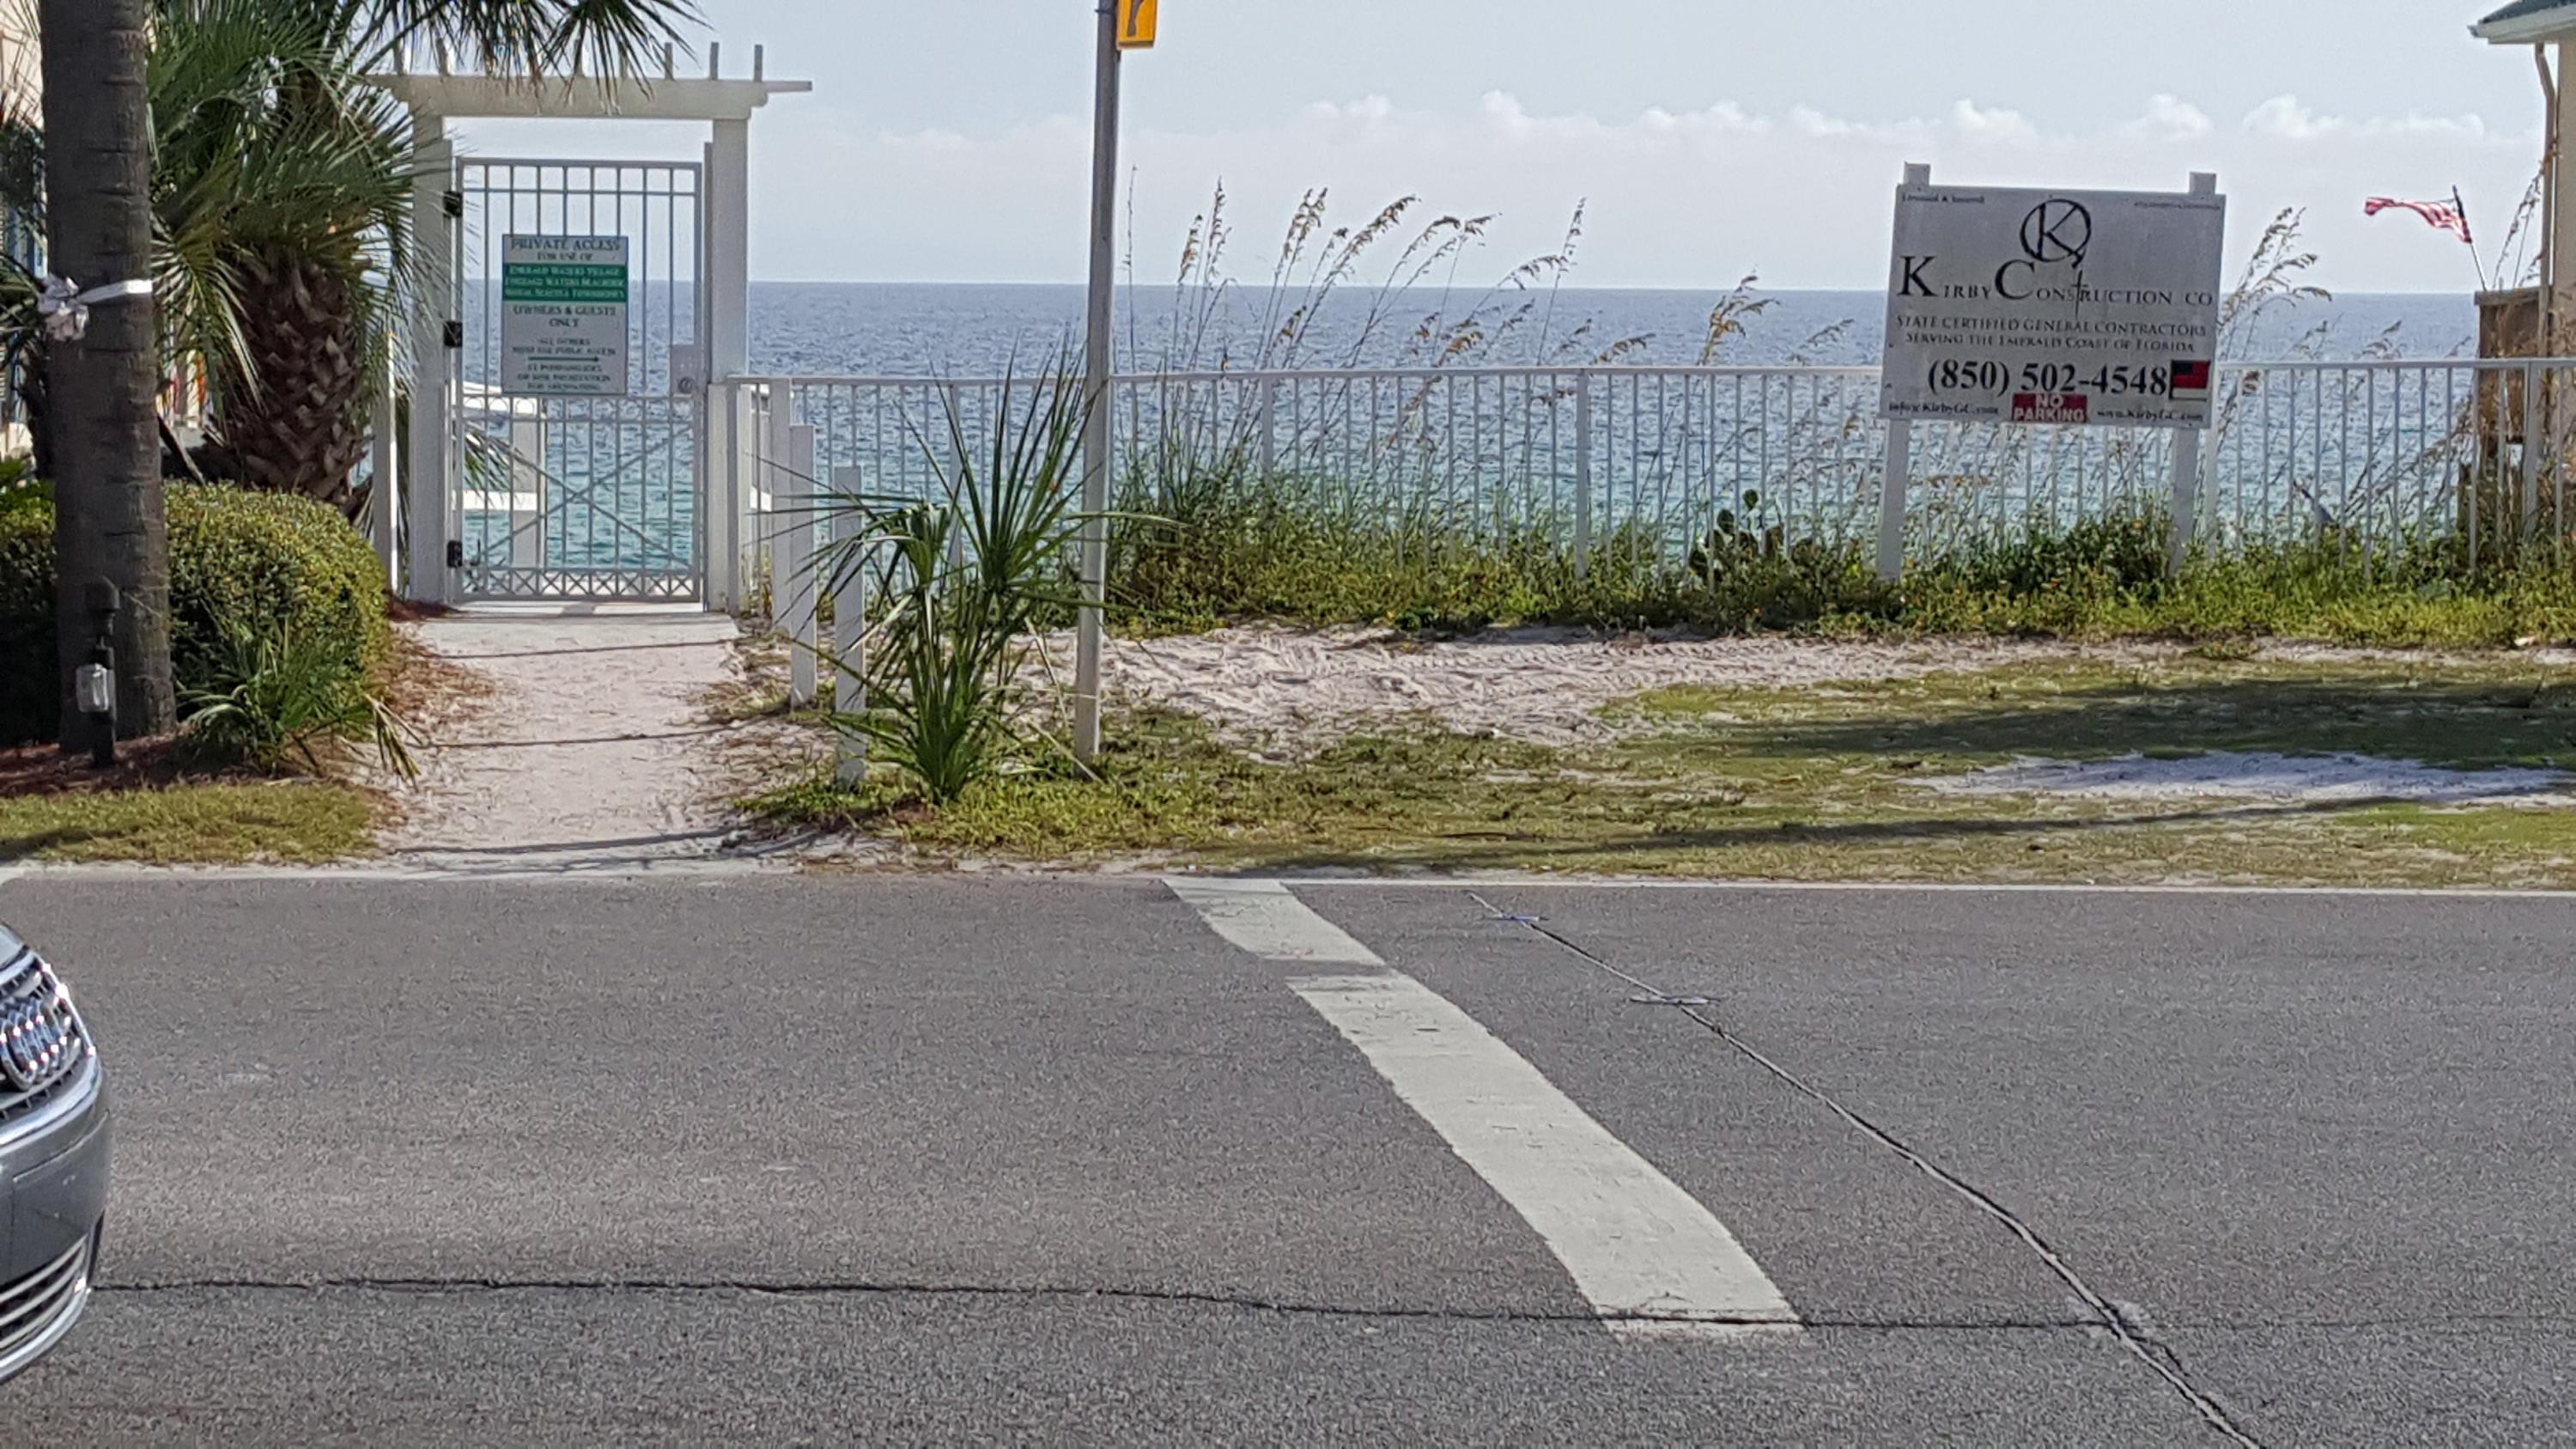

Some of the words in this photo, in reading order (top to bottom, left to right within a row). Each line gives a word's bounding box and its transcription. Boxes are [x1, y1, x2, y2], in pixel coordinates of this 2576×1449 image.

[510, 238, 567, 250] PRIVATE
[574, 240, 621, 251] ACCESS
[2184, 292, 2214, 307] CO
[513, 305, 562, 314] OWNERS
[575, 307, 616, 316] GUESTS
[549, 318, 580, 327] ONLY
[1897, 315, 1938, 328] STATE
[1941, 317, 2019, 331] CERTIFIED
[2023, 319, 2088, 332] GENERAL
[2094, 321, 2207, 337] CONTRACTORS
[1928, 359, 2010, 397] (850)
[2020, 362, 2167, 396] 502-4548
[2035, 393, 2064, 408] NO
[2013, 406, 2085, 422] PARKING
